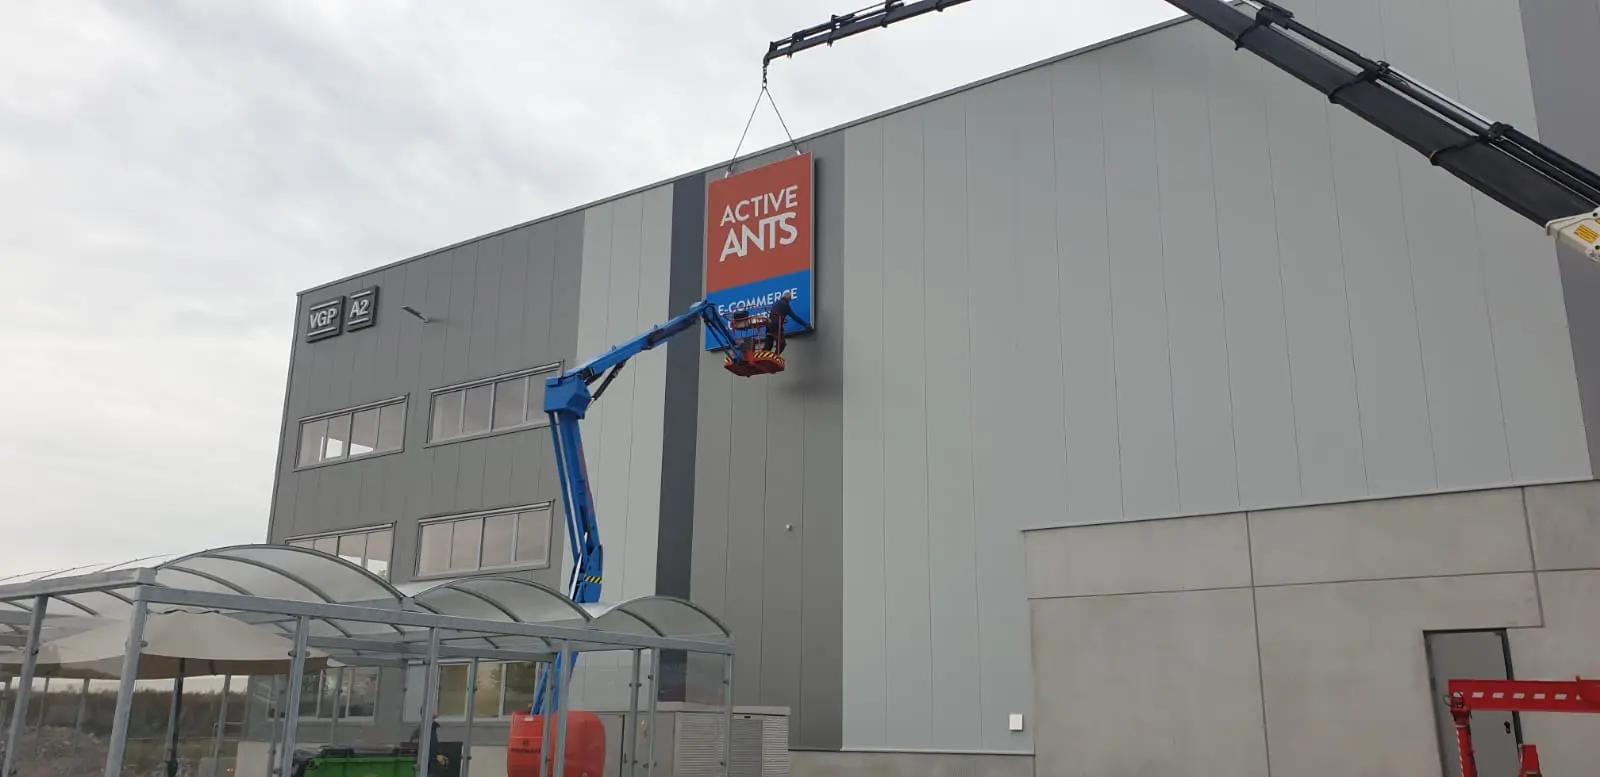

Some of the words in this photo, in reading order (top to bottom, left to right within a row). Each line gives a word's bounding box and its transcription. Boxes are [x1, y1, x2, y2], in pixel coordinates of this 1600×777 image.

[720, 185, 798, 227] ACTIVE
[719, 212, 798, 262] ANTS
[310, 308, 337, 329] VGP
[349, 299, 369, 318] A2
